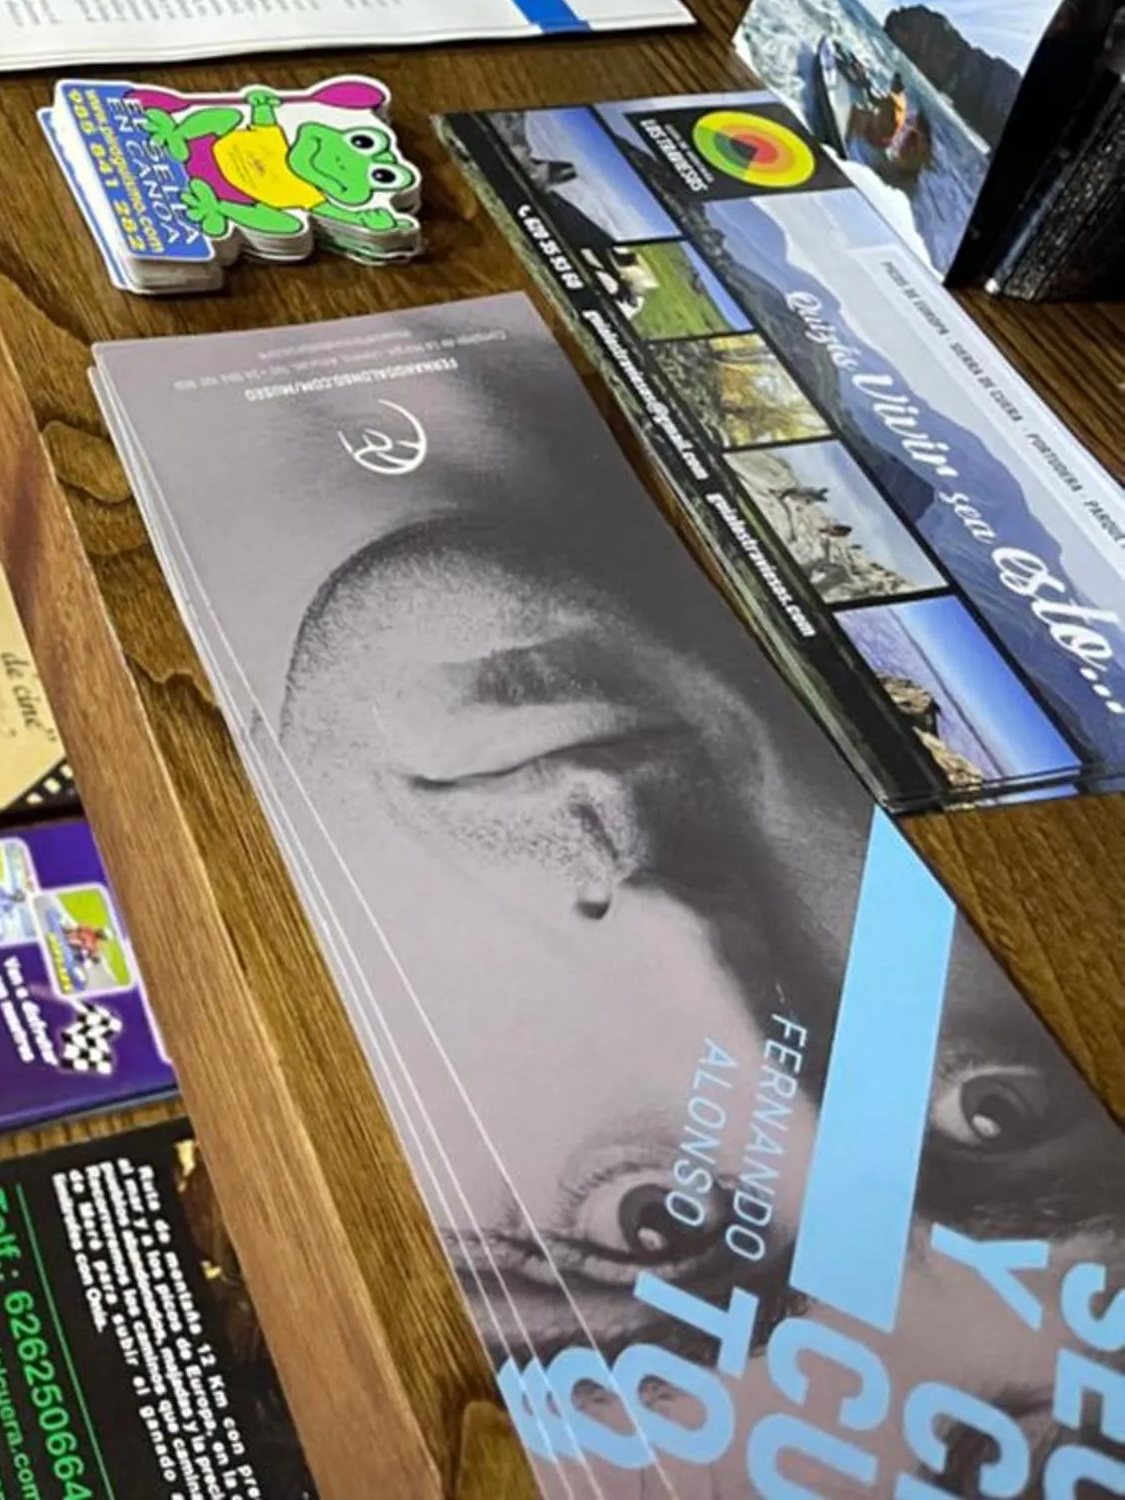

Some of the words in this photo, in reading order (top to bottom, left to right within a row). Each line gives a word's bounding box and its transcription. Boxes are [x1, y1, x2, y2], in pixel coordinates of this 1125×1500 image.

[106, 98, 131, 132] EN
[125, 140, 180, 244] CANOA
[146, 137, 200, 244] SELLA
[784, 289, 857, 376] Quizás
[851, 368, 957, 477] Vivir
[938, 475, 996, 543] sea
[664, 1037, 739, 1229] ALONSO
[725, 1012, 808, 1263] FERNANDO
[67, 1168, 86, 1194] de
[93, 1259, 116, 1305] para
[113, 1313, 139, 1367] subir
[139, 1405, 176, 1483] ganado
[74, 1252, 93, 1286] con
[122, 1288, 142, 1317] los
[133, 1319, 166, 1396] caminos
[156, 1399, 178, 1434] que
[137, 1165, 161, 1211] Ruta
[152, 1218, 172, 1244] de
[166, 1251, 202, 1335] montaña
[195, 1343, 214, 1367] 12
[206, 1375, 229, 1409] Km
[220, 1417, 244, 1455] con
[237, 1465, 261, 1500] pre
[146, 1250, 166, 1279] los
[156, 1282, 181, 1333] picos
[174, 1337, 194, 1361] de
[184, 1364, 218, 1438] Europa,
[210, 1441, 228, 1467] en
[931, 1222, 1050, 1332] Y
[3, 1289, 93, 1500] 626250664
